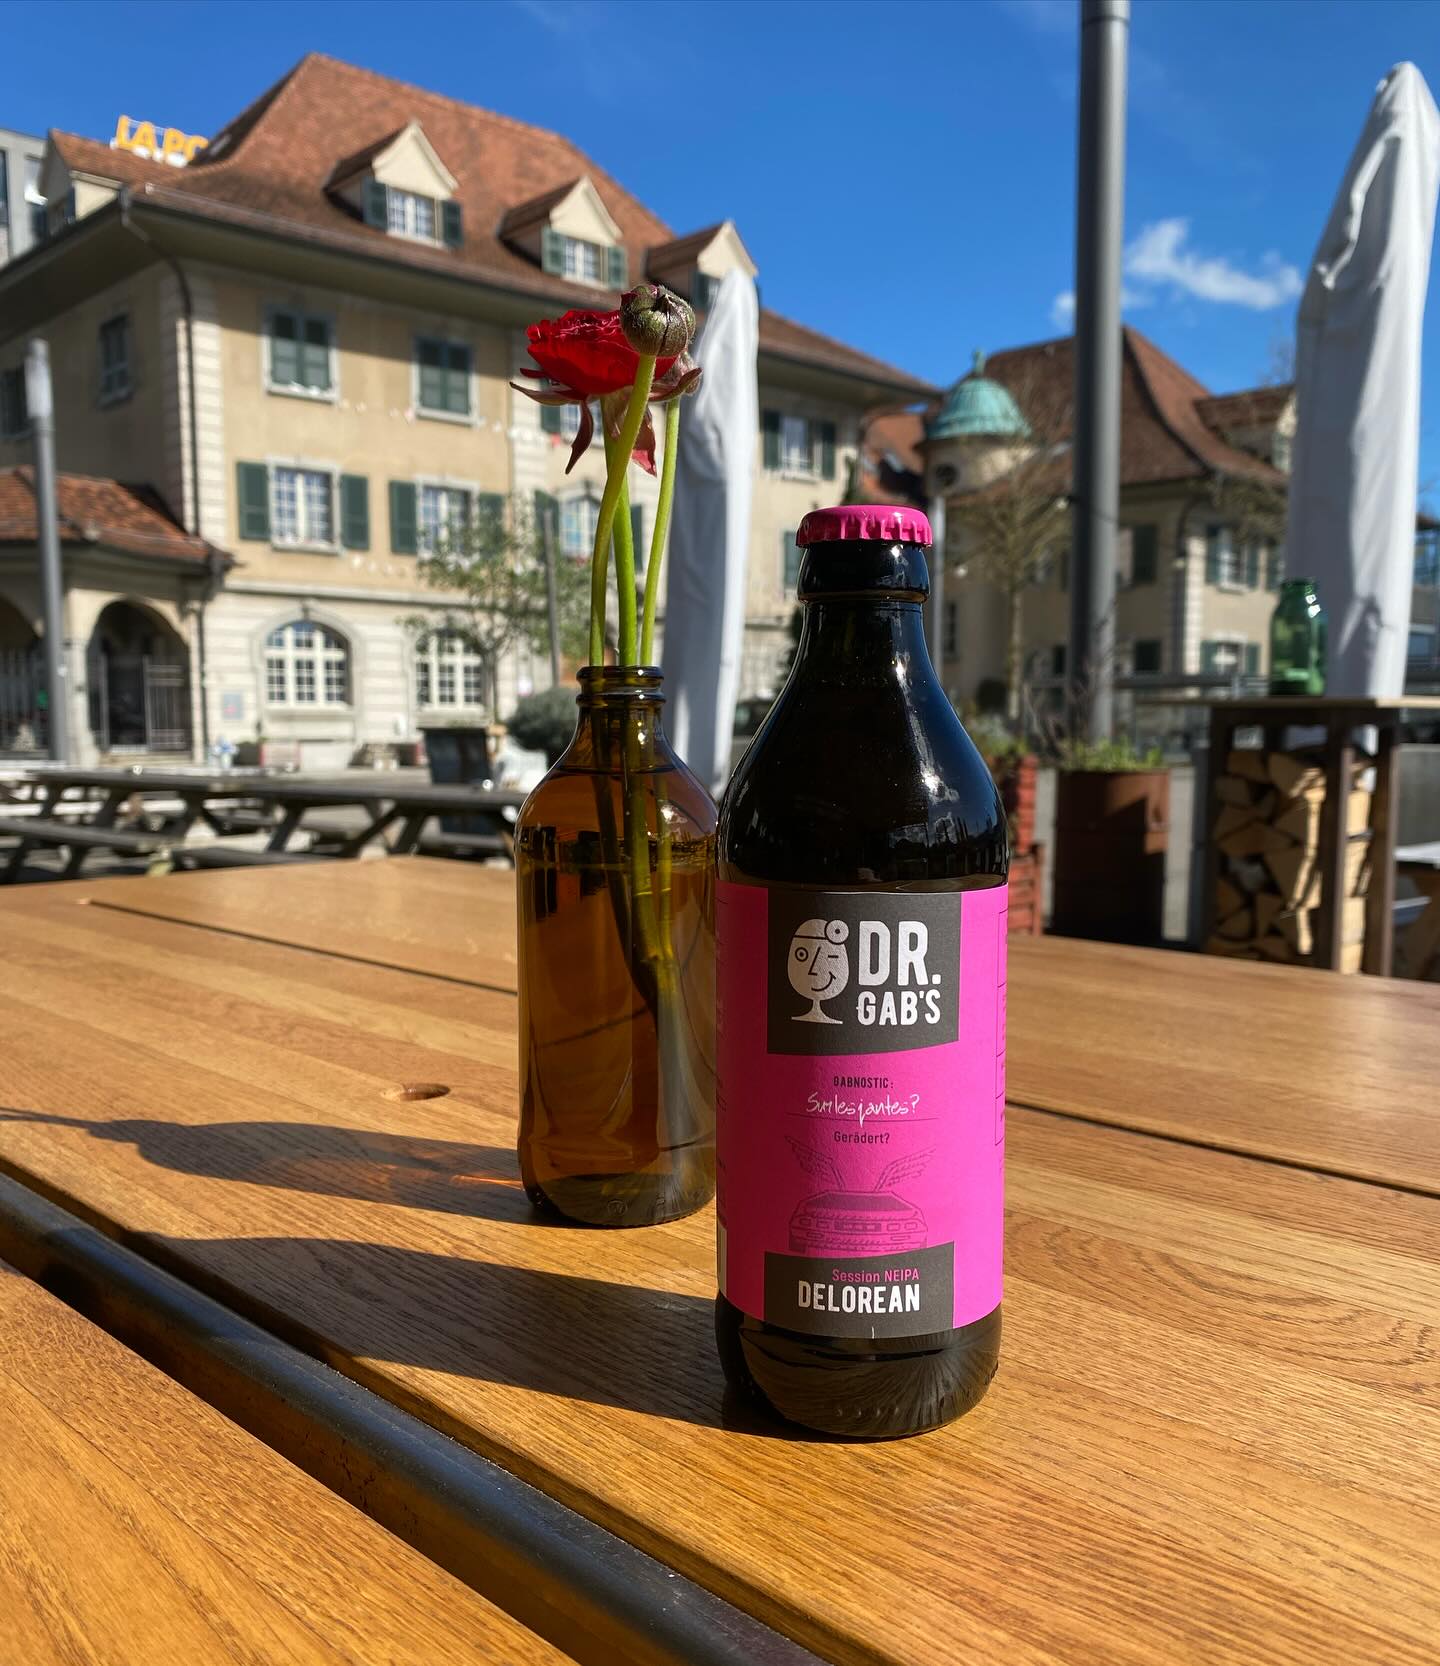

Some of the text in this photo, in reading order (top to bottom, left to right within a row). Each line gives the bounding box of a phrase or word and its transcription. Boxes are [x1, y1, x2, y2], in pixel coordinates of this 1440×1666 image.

[116, 114, 157, 156] LA
[858, 920, 942, 986] DR.
[856, 988, 942, 1026] GAB'S
[834, 1093, 856, 1115] les
[857, 1093, 920, 1128] jantes?
[834, 1131, 890, 1144] Gerädert?
[832, 1268, 920, 1283] Session NEIPA
[798, 1280, 920, 1314] DELOREAN
